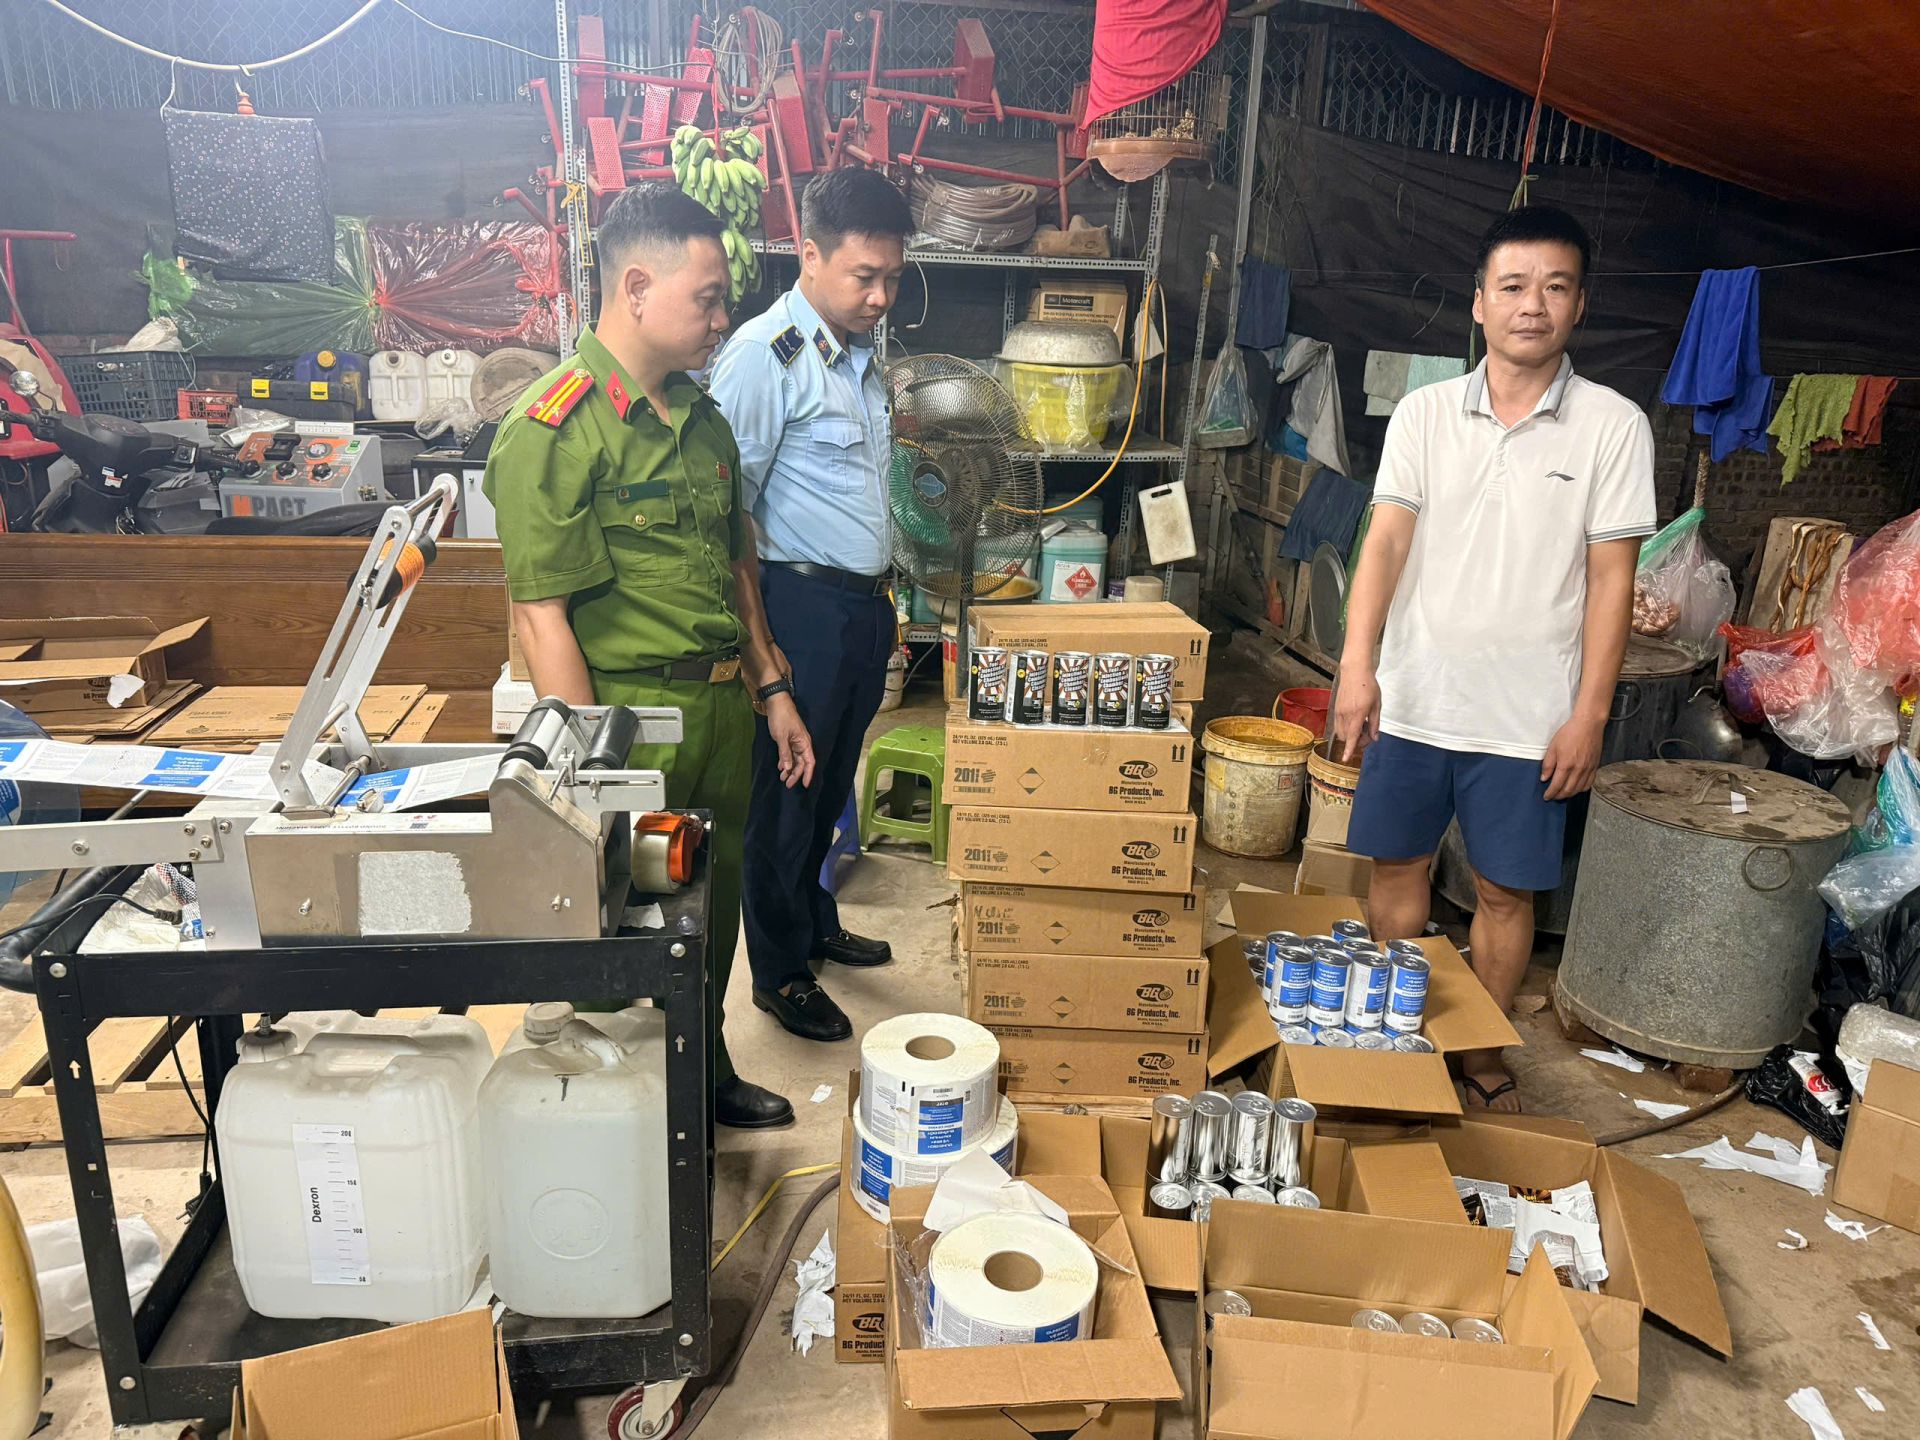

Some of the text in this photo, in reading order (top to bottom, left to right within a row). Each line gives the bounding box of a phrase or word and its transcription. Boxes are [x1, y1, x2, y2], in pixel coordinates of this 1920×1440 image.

[1062, 297, 1091, 305] Motorcraft
[224, 495, 307, 516] IMPACT
[1109, 786, 1164, 797] BG Products, Inc.
[1112, 866, 1167, 877] BG Products, Inc.
[1123, 933, 1176, 943] BG Products, Inc.
[1127, 1007, 1180, 1018] BG Products, Inc.
[1128, 1076, 1181, 1086] BG Products, Inc.
[310, 1187, 322, 1223] Dexron
[842, 1340, 853, 1349] BG
